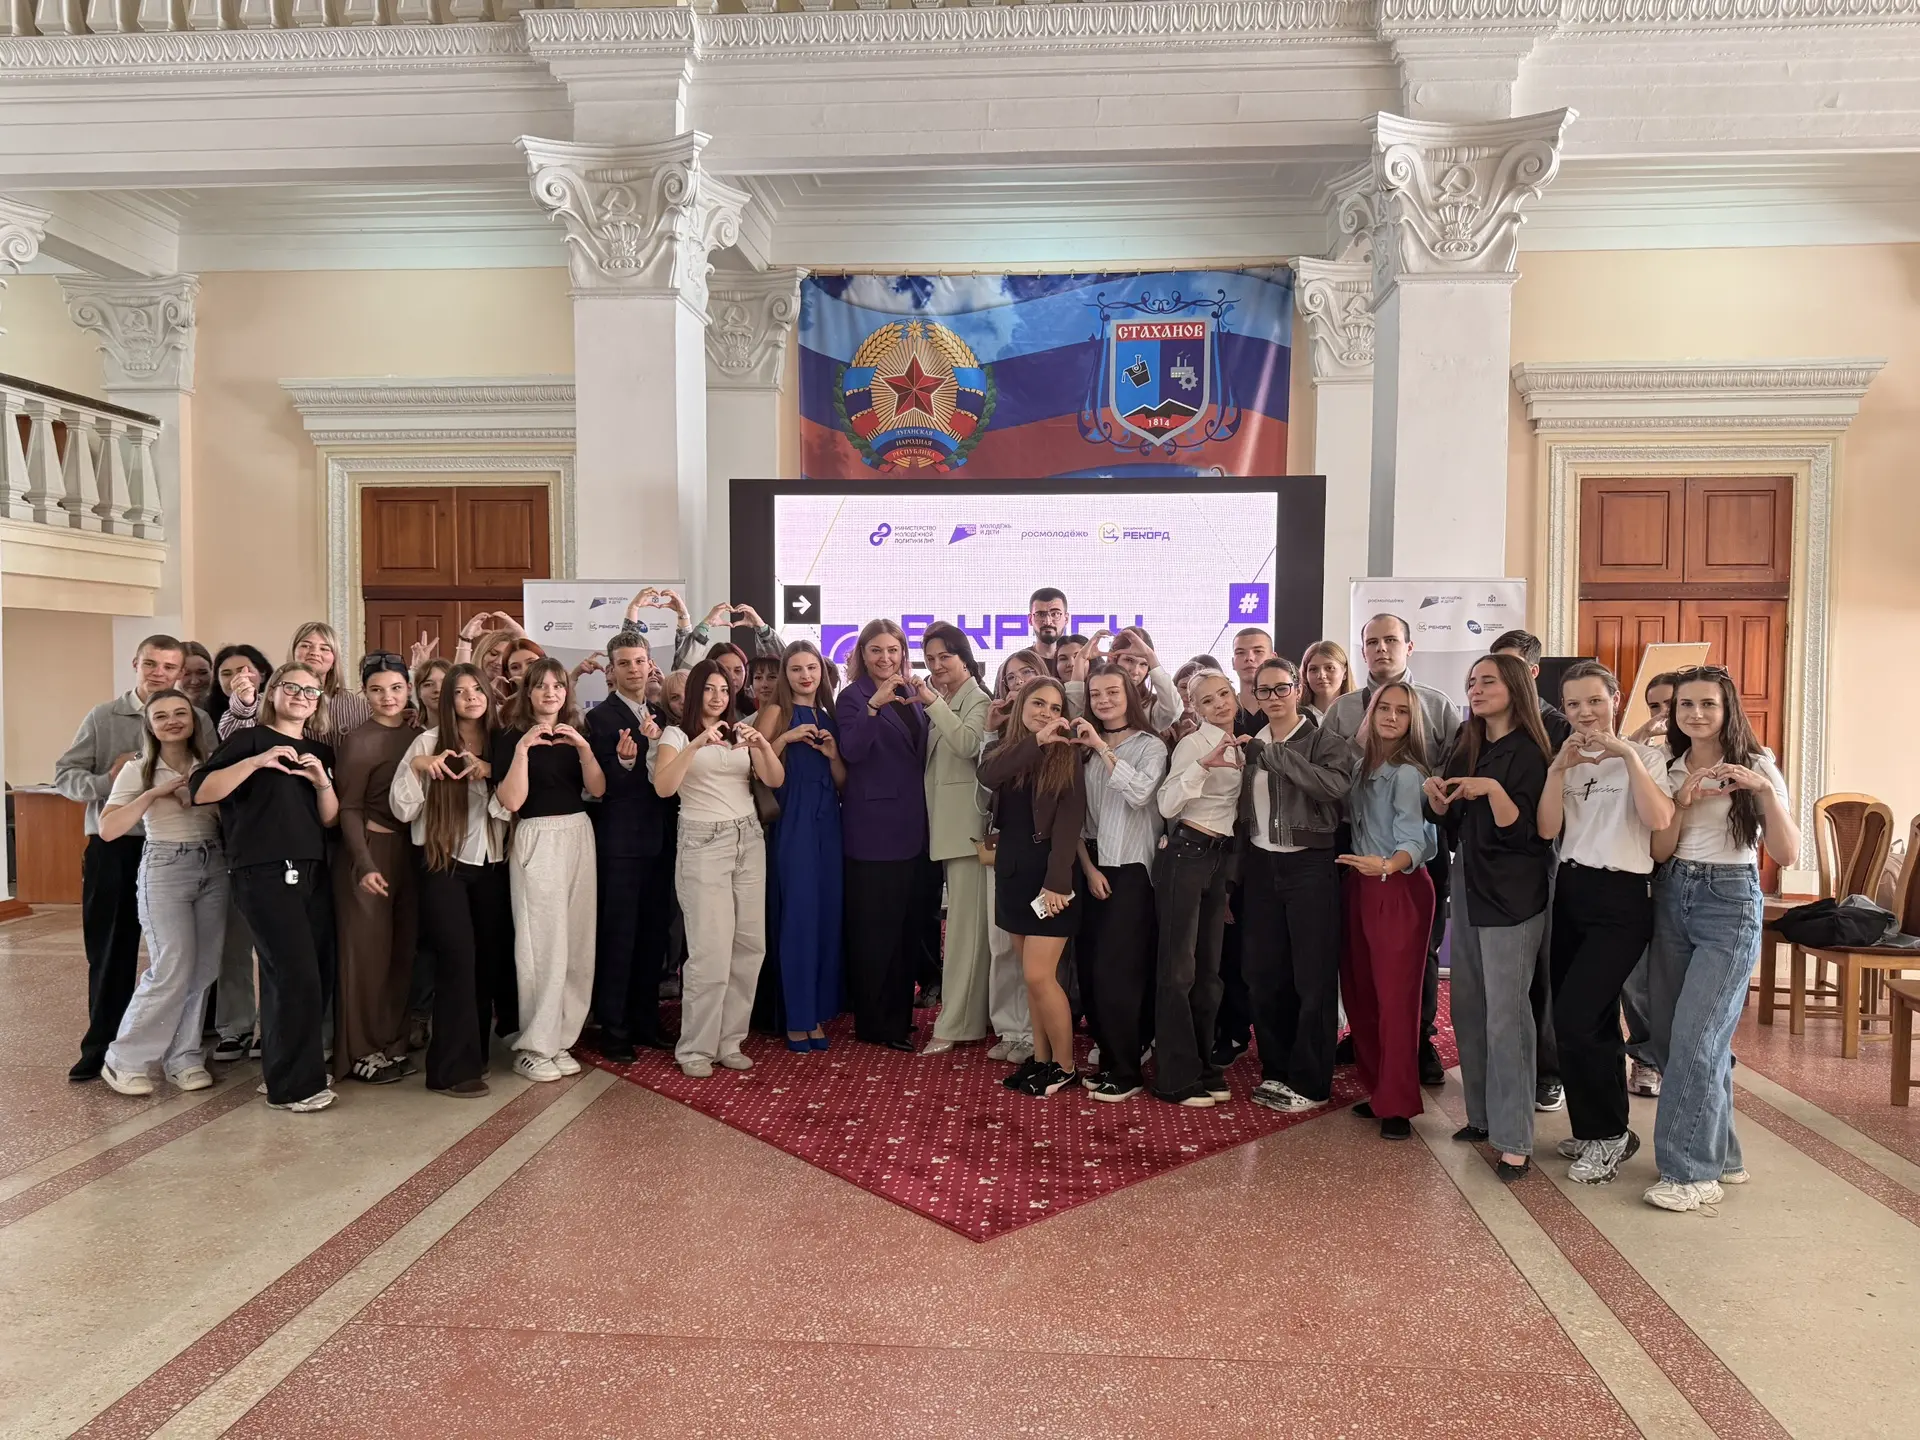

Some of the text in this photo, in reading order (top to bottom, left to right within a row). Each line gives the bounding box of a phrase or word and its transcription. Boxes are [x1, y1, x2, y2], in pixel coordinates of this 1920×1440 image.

[1117, 324, 1204, 339] СТАХАНОВ
[1148, 418, 1170, 427] 1814
[895, 427, 934, 437] ЛУГАНСКАЯ
[895, 438, 933, 447] НАРОДНАЯ
[892, 448, 936, 458] РЕСПУБЛИКА
[1123, 531, 1171, 541] РЕКОРД
[902, 615, 934, 649] В
